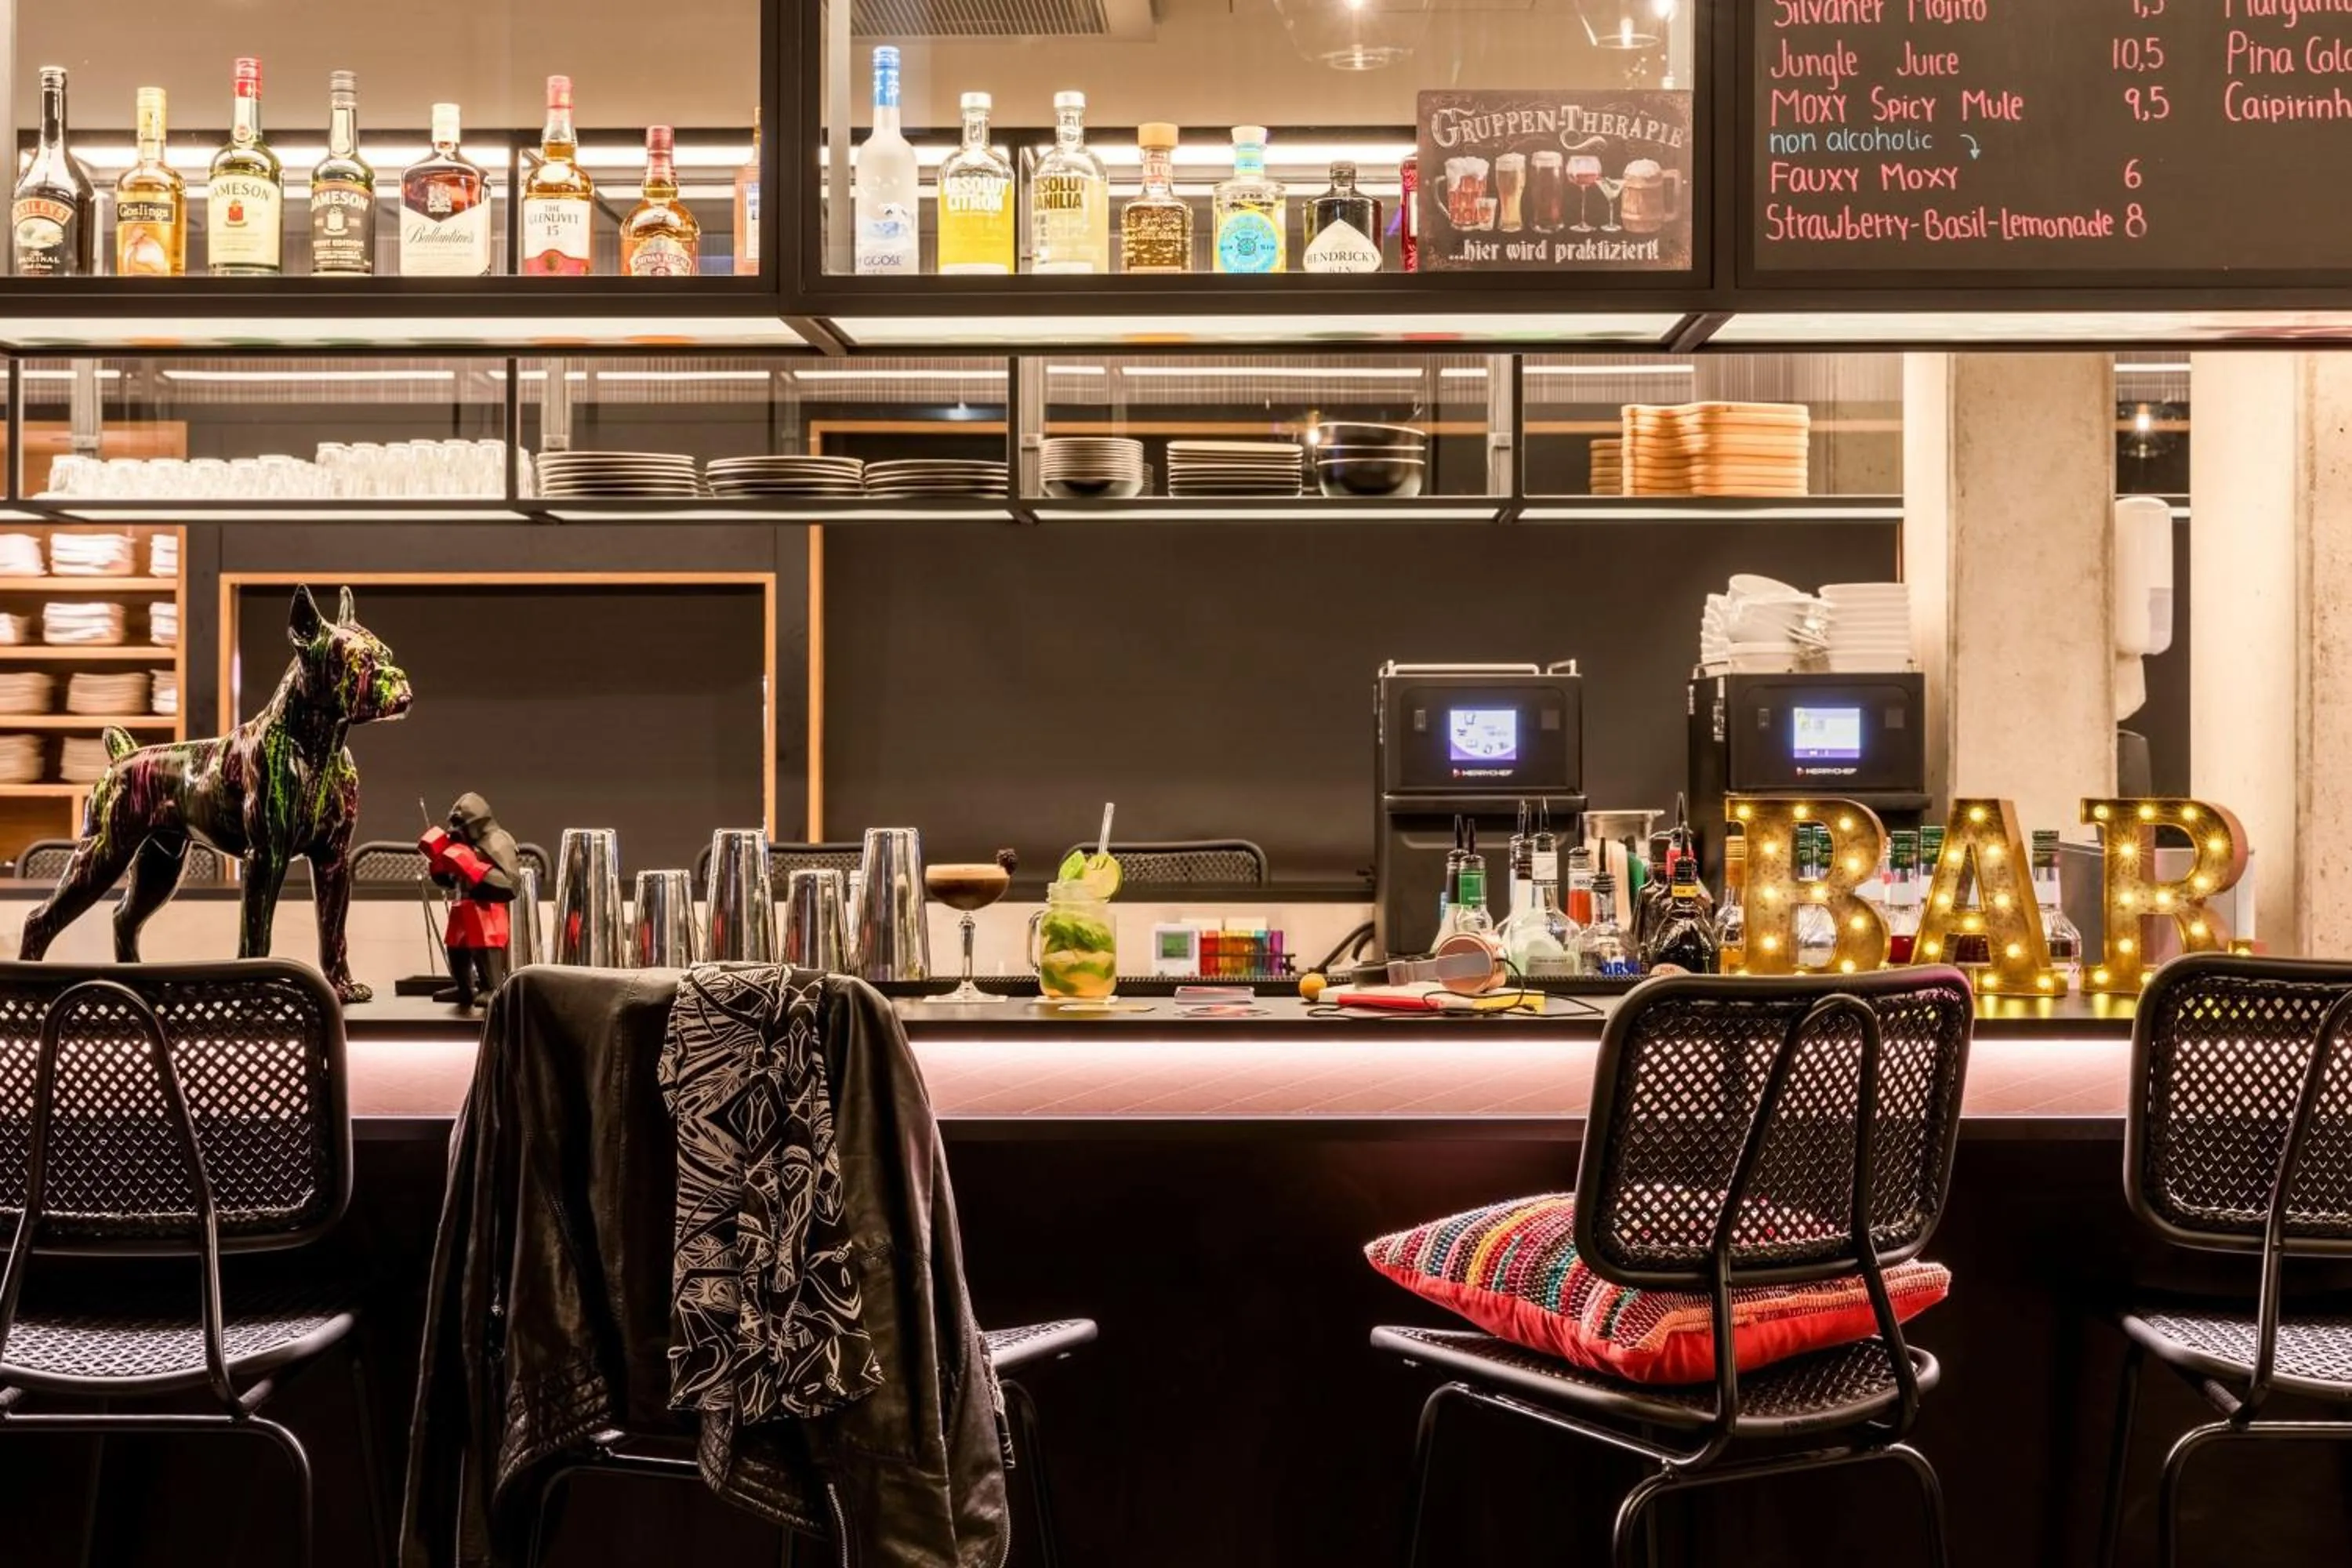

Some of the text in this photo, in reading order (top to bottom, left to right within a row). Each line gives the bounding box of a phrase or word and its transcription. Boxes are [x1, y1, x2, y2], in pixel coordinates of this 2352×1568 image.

[1773, 0, 1884, 27] Silvaner
[1770, 37, 2165, 91] Jungle Juice 10,5
[2227, 30, 2296, 74] Pina
[1962, 89, 2024, 121] Mule
[2125, 85, 2170, 122] 9,5
[1769, 126, 1933, 154] non alcoholic
[1770, 161, 1860, 194] Fauxy
[2125, 158, 2142, 189] 6
[15, 199, 69, 221] AILEYS
[119, 203, 169, 220] Goslings
[311, 191, 369, 212] JAMESON
[528, 212, 579, 226] GLENLIVET
[546, 225, 560, 236] 15
[1766, 203, 2147, 241] Strawberry-Basil-Lemonade 8
[1505, 238, 1548, 261] wird
[1725, 797, 2252, 996] BAR
